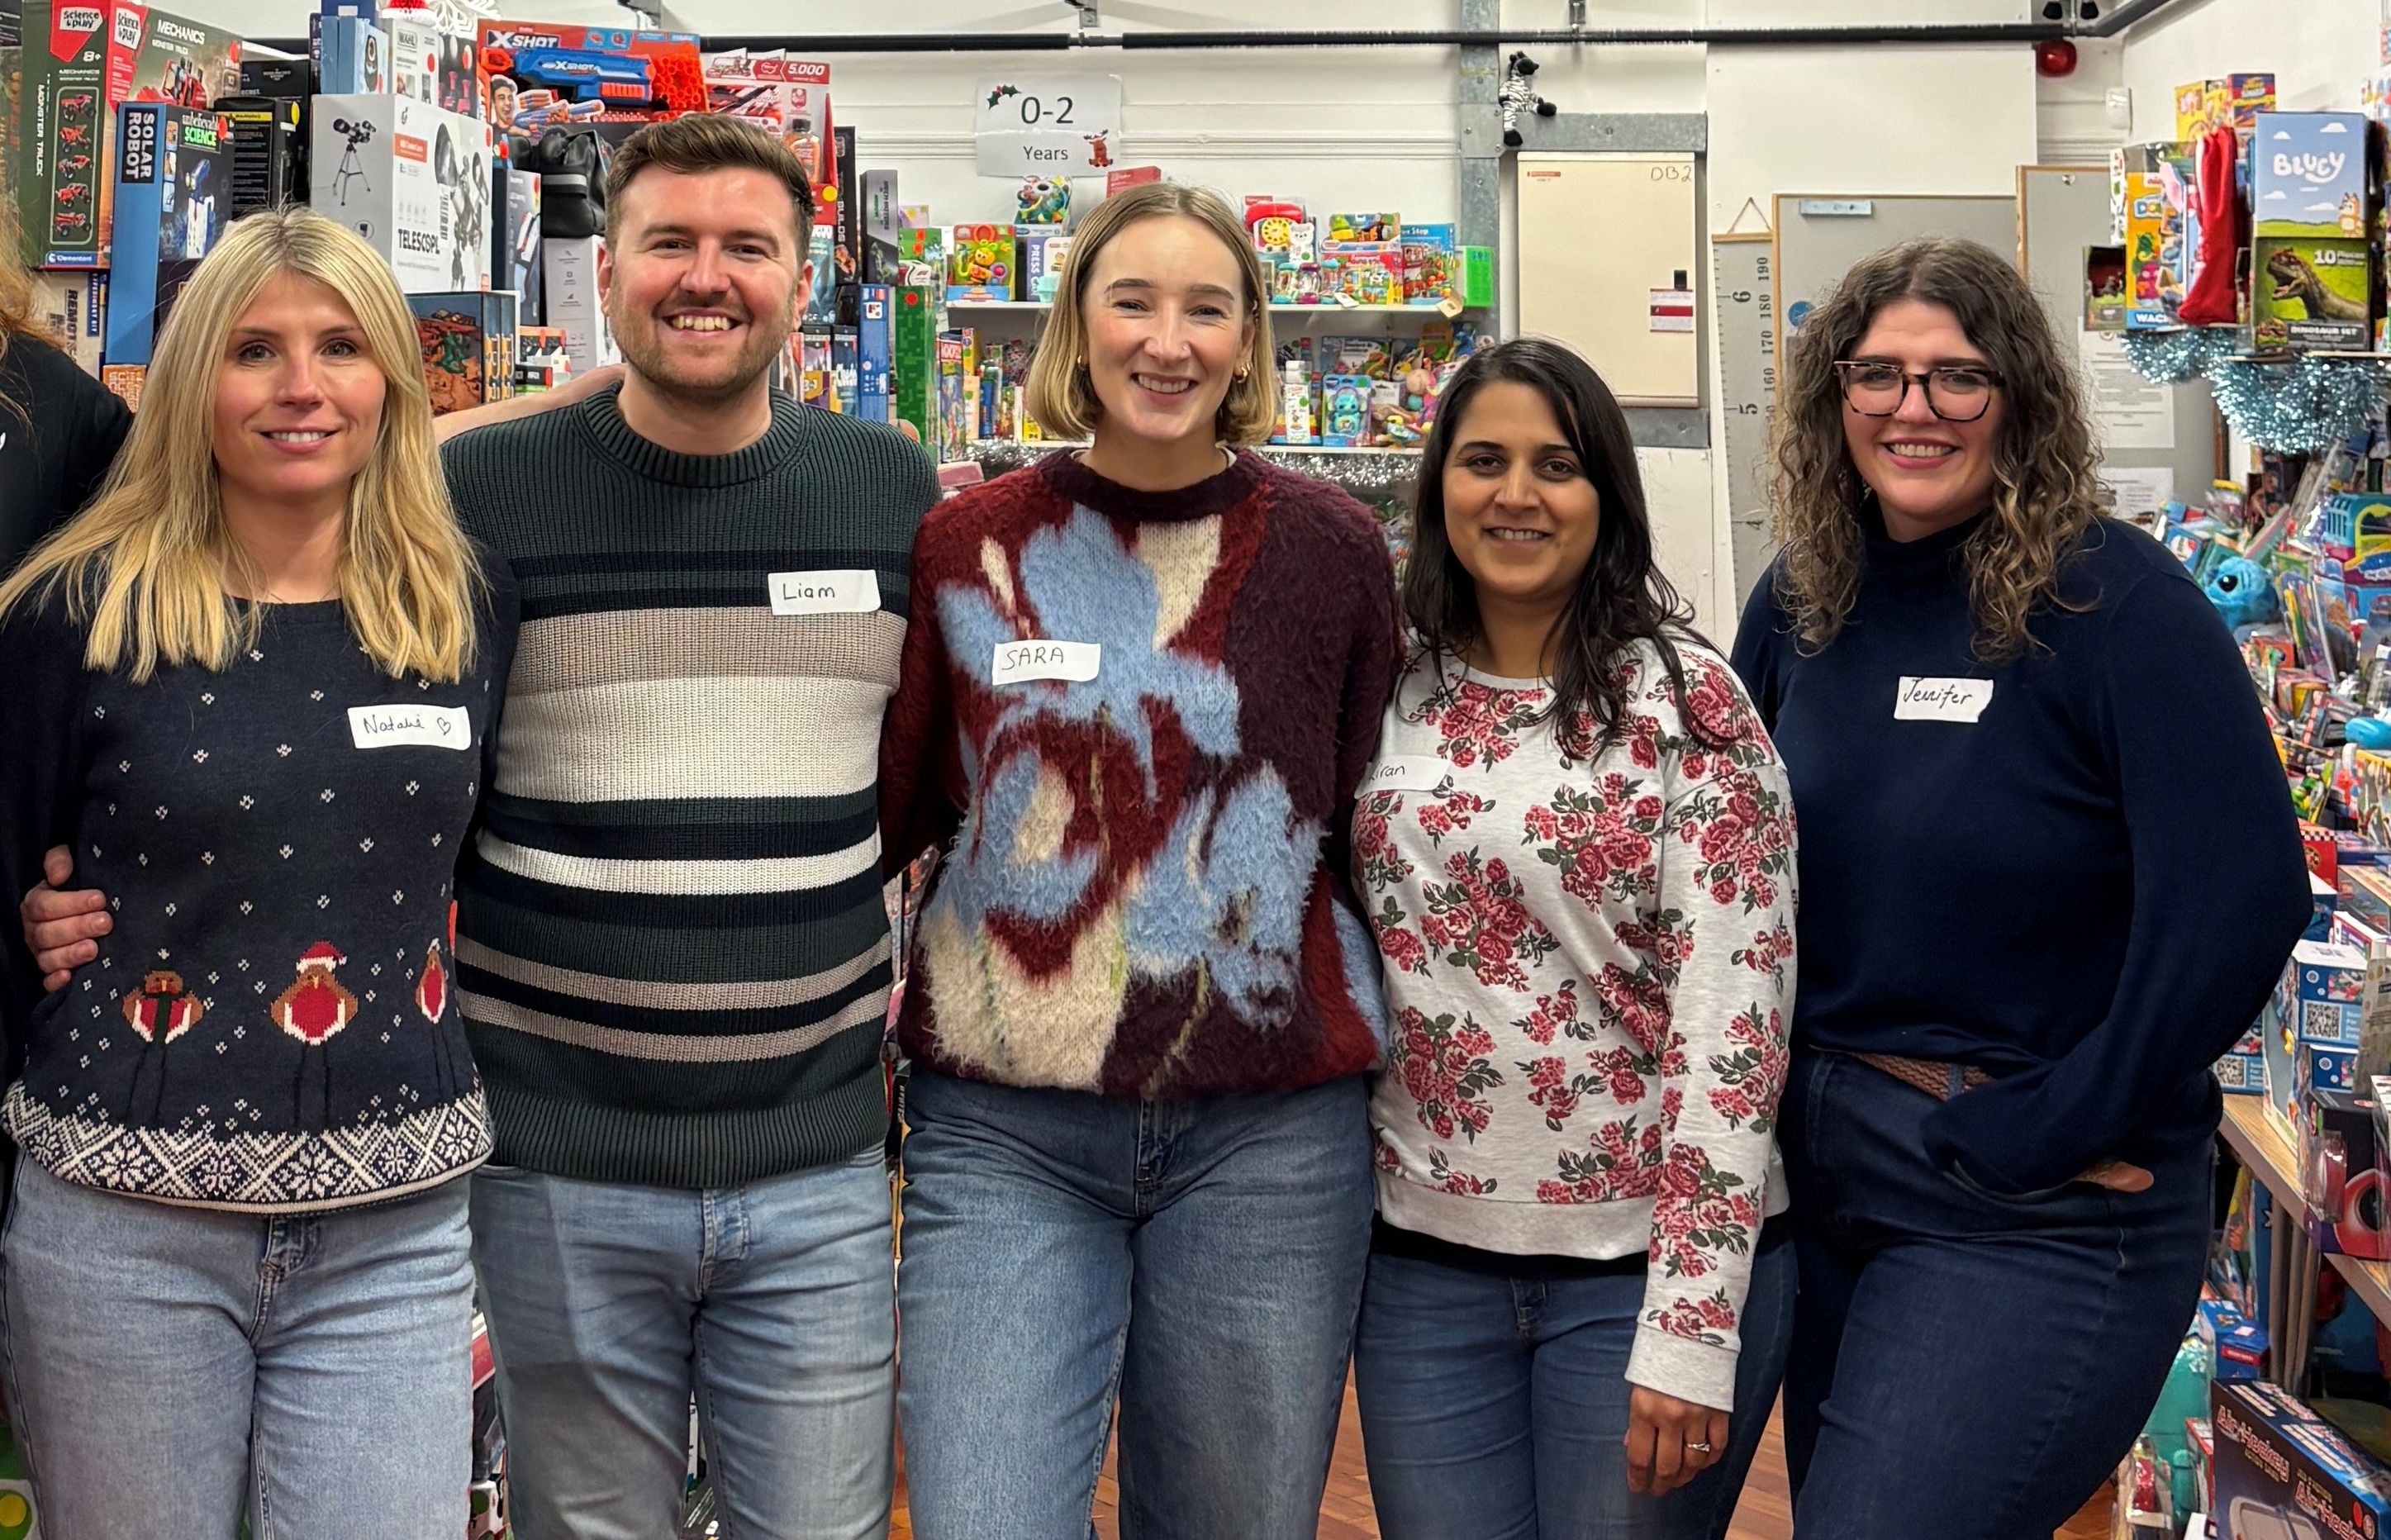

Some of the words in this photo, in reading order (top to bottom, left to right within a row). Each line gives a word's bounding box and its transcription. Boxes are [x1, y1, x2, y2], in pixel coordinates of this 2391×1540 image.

[64, 10, 100, 20] Science
[156, 19, 205, 45] MECHANICS
[83, 50, 102, 62] 8+
[1020, 96, 1074, 125] 0-2
[125, 112, 141, 179] ROBOT
[141, 112, 155, 178] SOLAR
[183, 126, 217, 147] SCIENCE
[36, 140, 45, 177] TRUCK
[1023, 145, 1069, 161] Years
[1650, 164, 1693, 182] DB2
[1031, 244, 1041, 274] PRESS
[1756, 256, 1770, 281] 190
[2314, 249, 2336, 265] 10
[1732, 290, 1752, 303] 6
[1758, 294, 1772, 320] 180
[1761, 330, 1774, 355] 170
[1762, 368, 1776, 392] 160
[1738, 402, 1758, 415] 5
[782, 582, 835, 601] Liam
[1001, 646, 1065, 671] SARA
